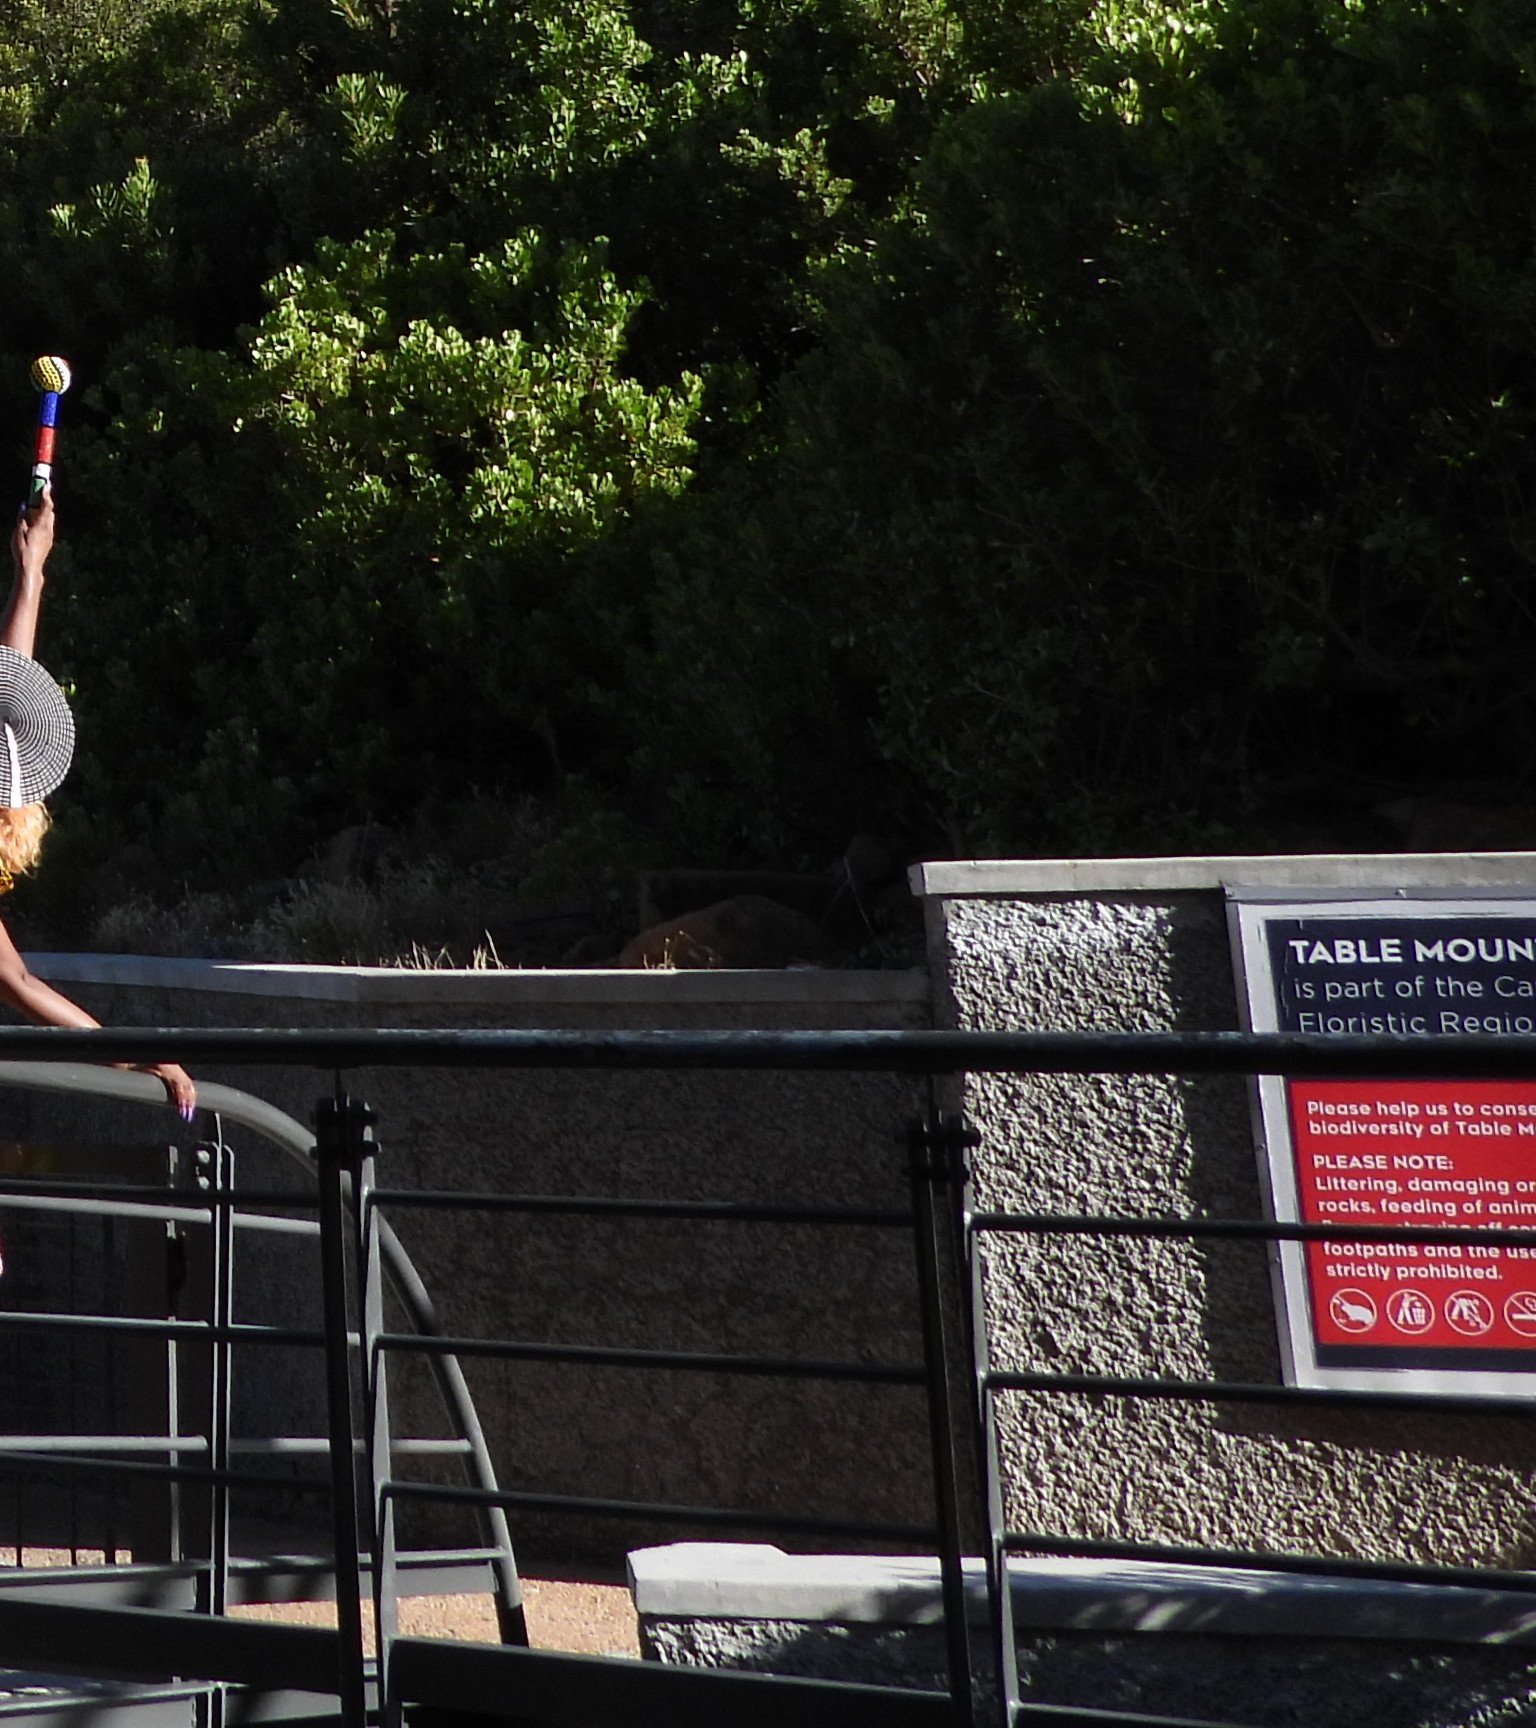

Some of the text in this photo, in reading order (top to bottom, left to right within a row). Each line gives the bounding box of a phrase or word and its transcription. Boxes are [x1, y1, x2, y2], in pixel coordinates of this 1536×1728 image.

[1288, 938, 1536, 964] TABLE MOUN
[1294, 978, 1315, 999] is
[1325, 978, 1385, 1002] part
[1395, 975, 1424, 998] of
[1436, 976, 1483, 998] the
[1298, 1011, 1427, 1033] Floristic
[1307, 1101, 1371, 1116] Please
[1377, 1100, 1420, 1118] help
[1425, 1104, 1448, 1116] us
[1454, 1102, 1475, 1116] to
[1309, 1120, 1424, 1139] biodiversity
[1430, 1121, 1450, 1136] of
[1455, 1121, 1512, 1136] Table
[1313, 1154, 1454, 1170] PLEASE NOTE:
[1315, 1176, 1403, 1194] Littering,
[1408, 1177, 1510, 1195] damaging
[1318, 1198, 1376, 1214] rocks,
[1380, 1198, 1457, 1216] feeding
[1463, 1200, 1482, 1214] of
[1323, 1242, 1418, 1259] footpaths
[1424, 1244, 1462, 1258] and
[1468, 1246, 1499, 1258] the
[1327, 1263, 1504, 1280] strictly prohibited.
